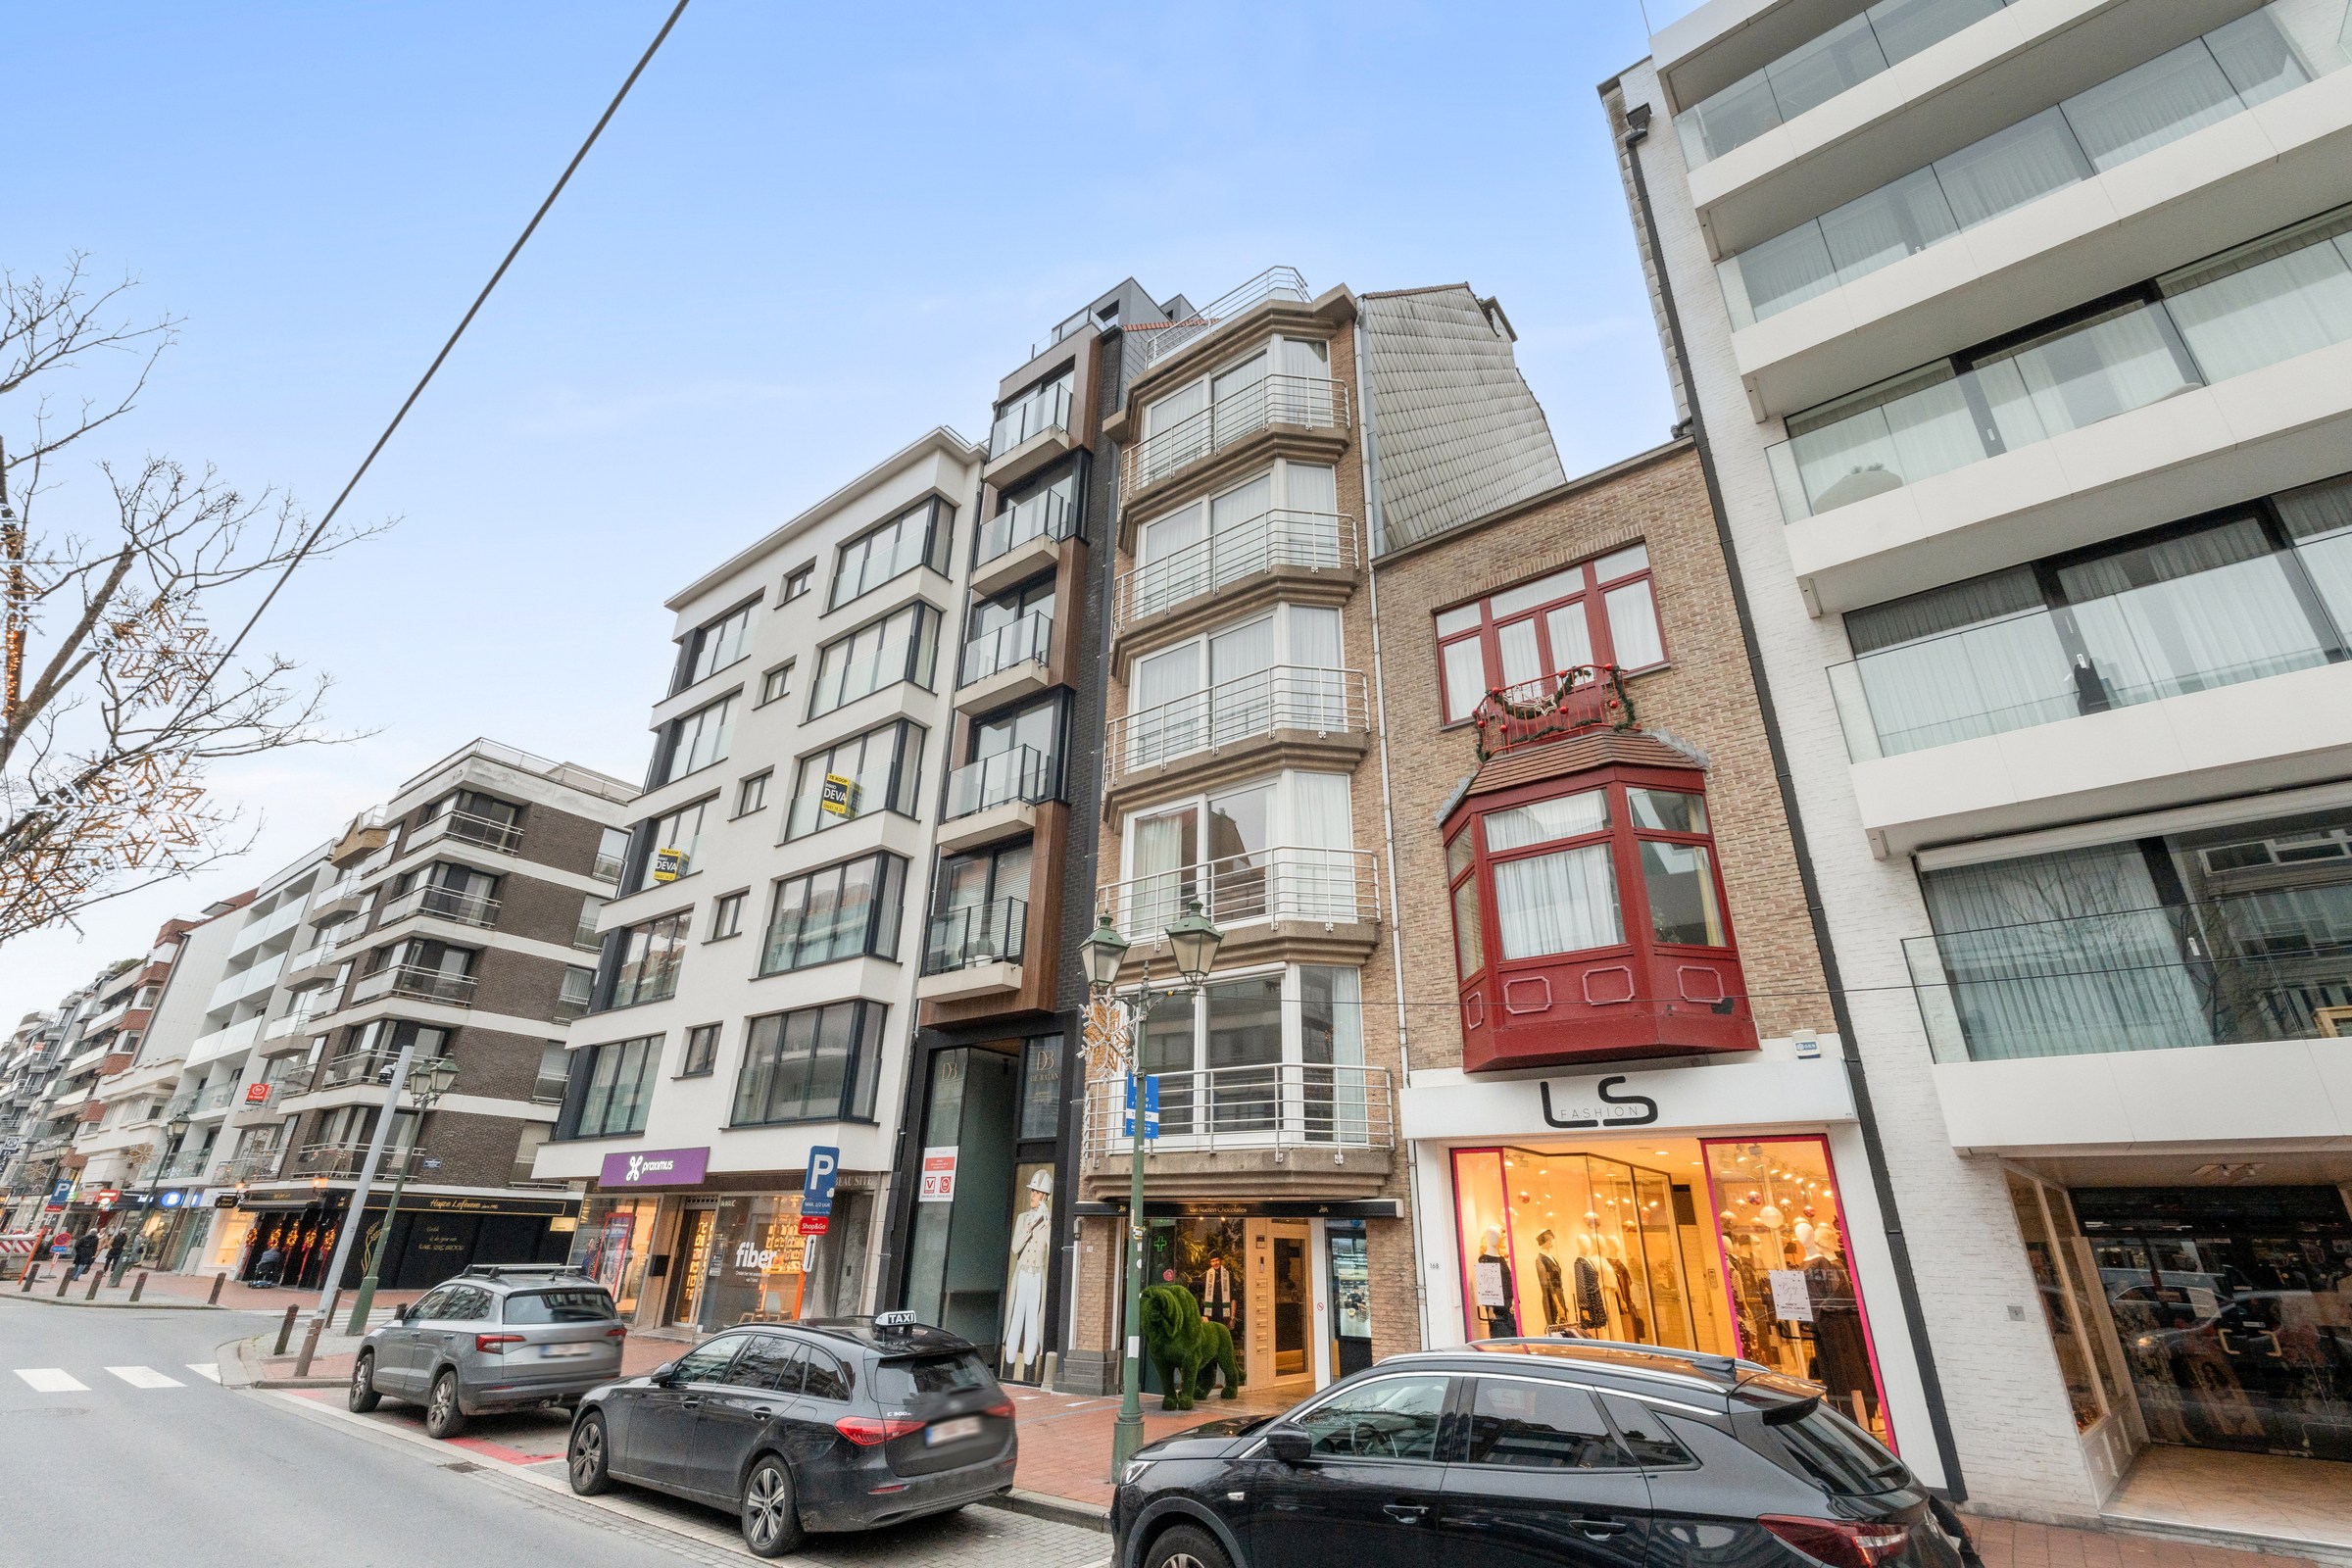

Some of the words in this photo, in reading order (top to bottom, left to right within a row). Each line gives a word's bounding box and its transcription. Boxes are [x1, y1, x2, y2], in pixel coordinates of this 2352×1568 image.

[823, 787, 846, 802] DEVA
[656, 860, 676, 871] DEVA
[1540, 1075, 1658, 1128] LS
[1560, 1105, 1639, 1119] FASHION
[642, 1160, 673, 1174] proximus
[809, 1153, 834, 1191] P
[854, 1176, 872, 1186] SITE
[54, 1183, 70, 1197] P
[1217, 1204, 1248, 1213] Chocolates
[801, 1222, 826, 1231] Shop&Go
[735, 1242, 777, 1268] fiber
[889, 1314, 914, 1323] TAXI
